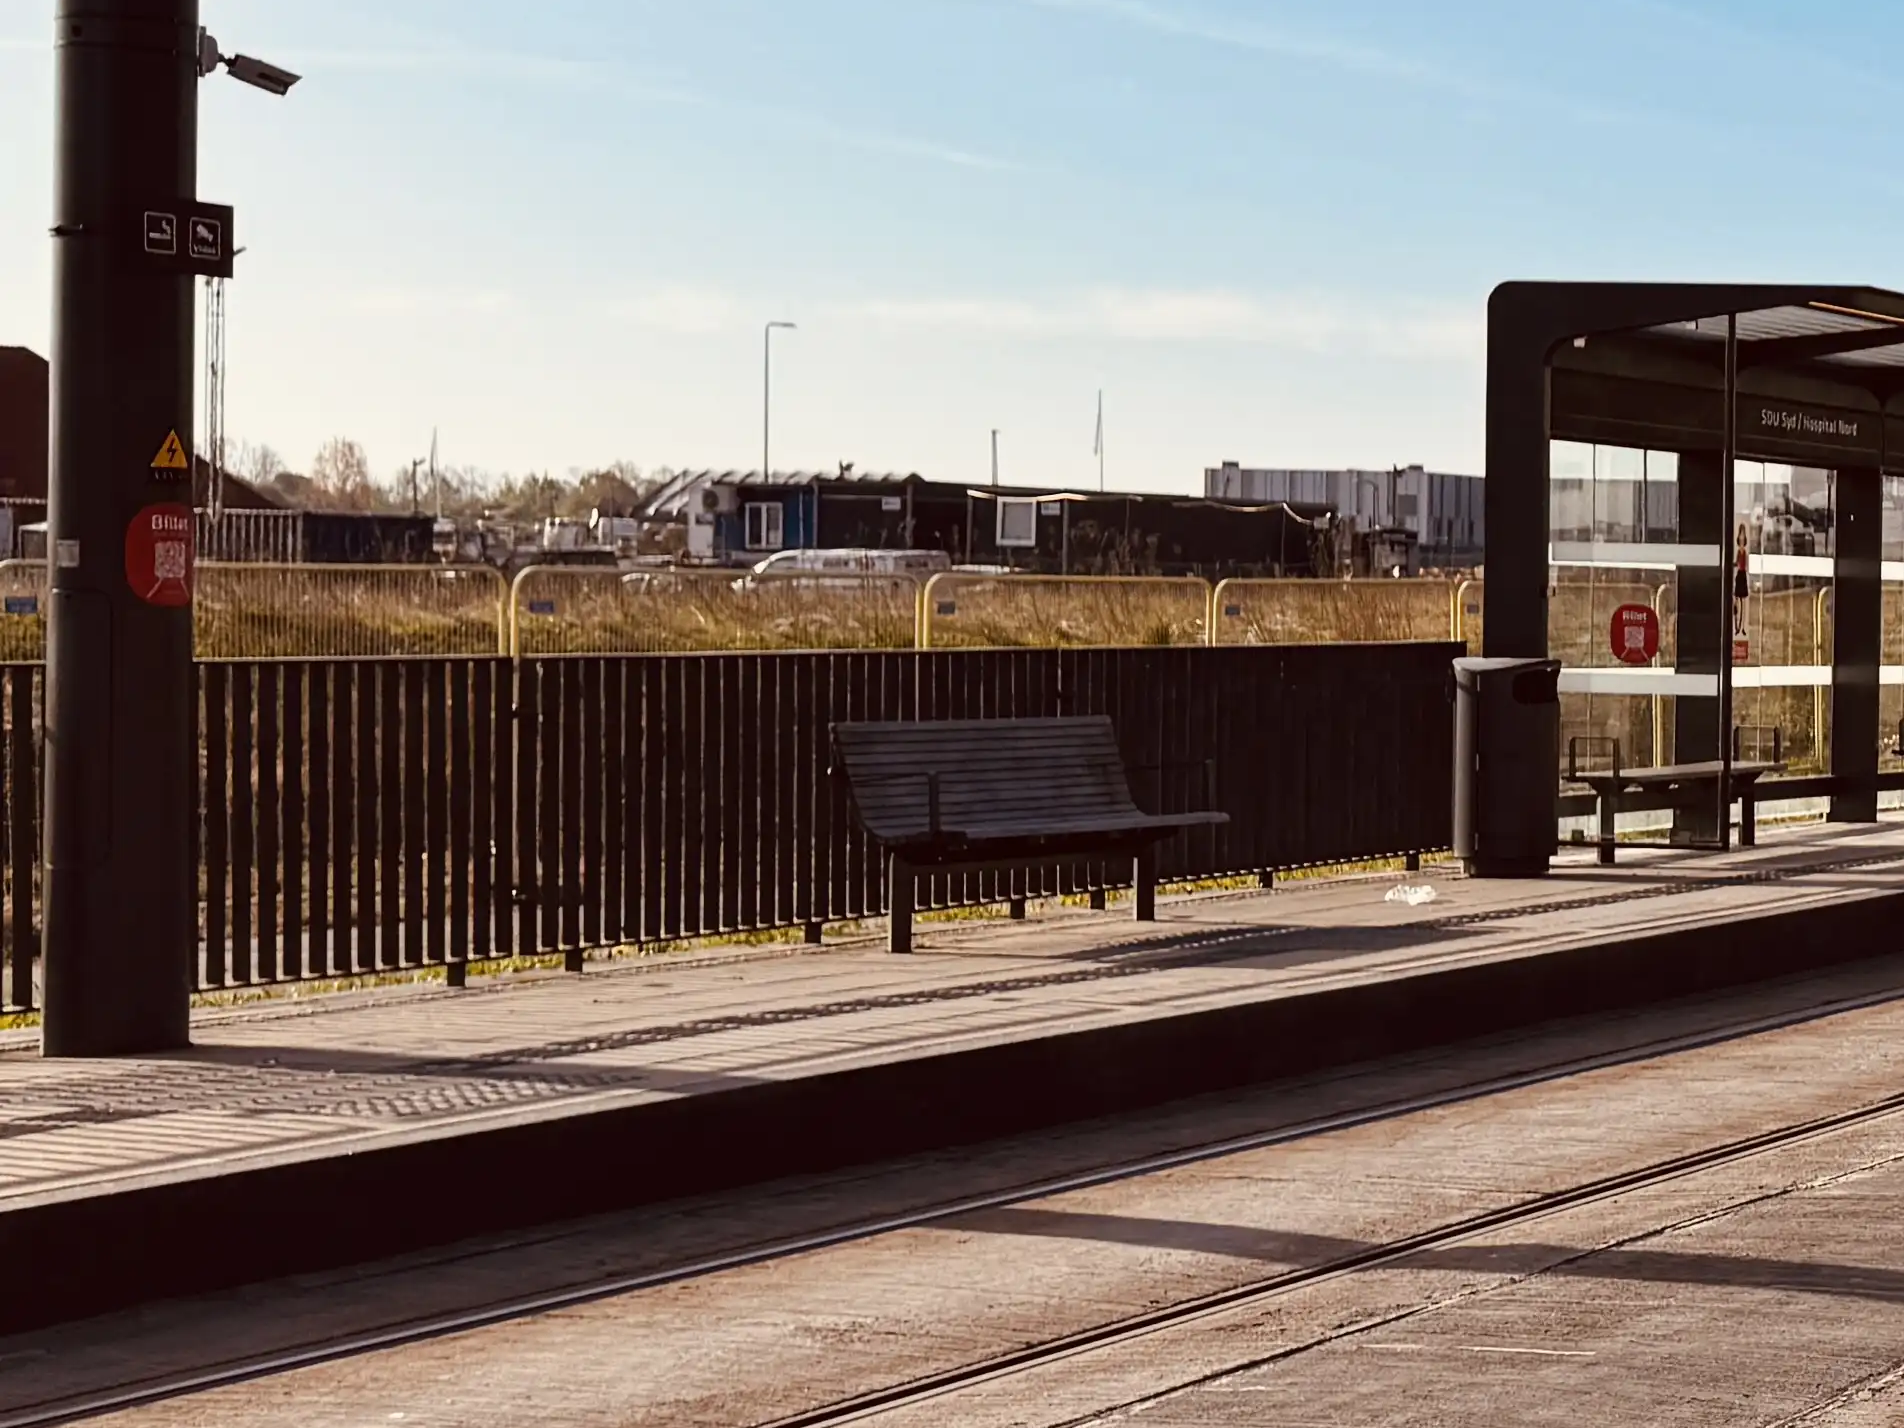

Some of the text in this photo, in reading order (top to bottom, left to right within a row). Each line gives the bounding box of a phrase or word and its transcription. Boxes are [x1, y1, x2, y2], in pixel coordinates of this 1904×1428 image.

[1761, 408, 1780, 427] SDU
[1781, 411, 1797, 431] Syd
[1803, 415, 1837, 434] Hospital
[1838, 419, 1858, 437] Nord
[151, 514, 189, 531] Billet
